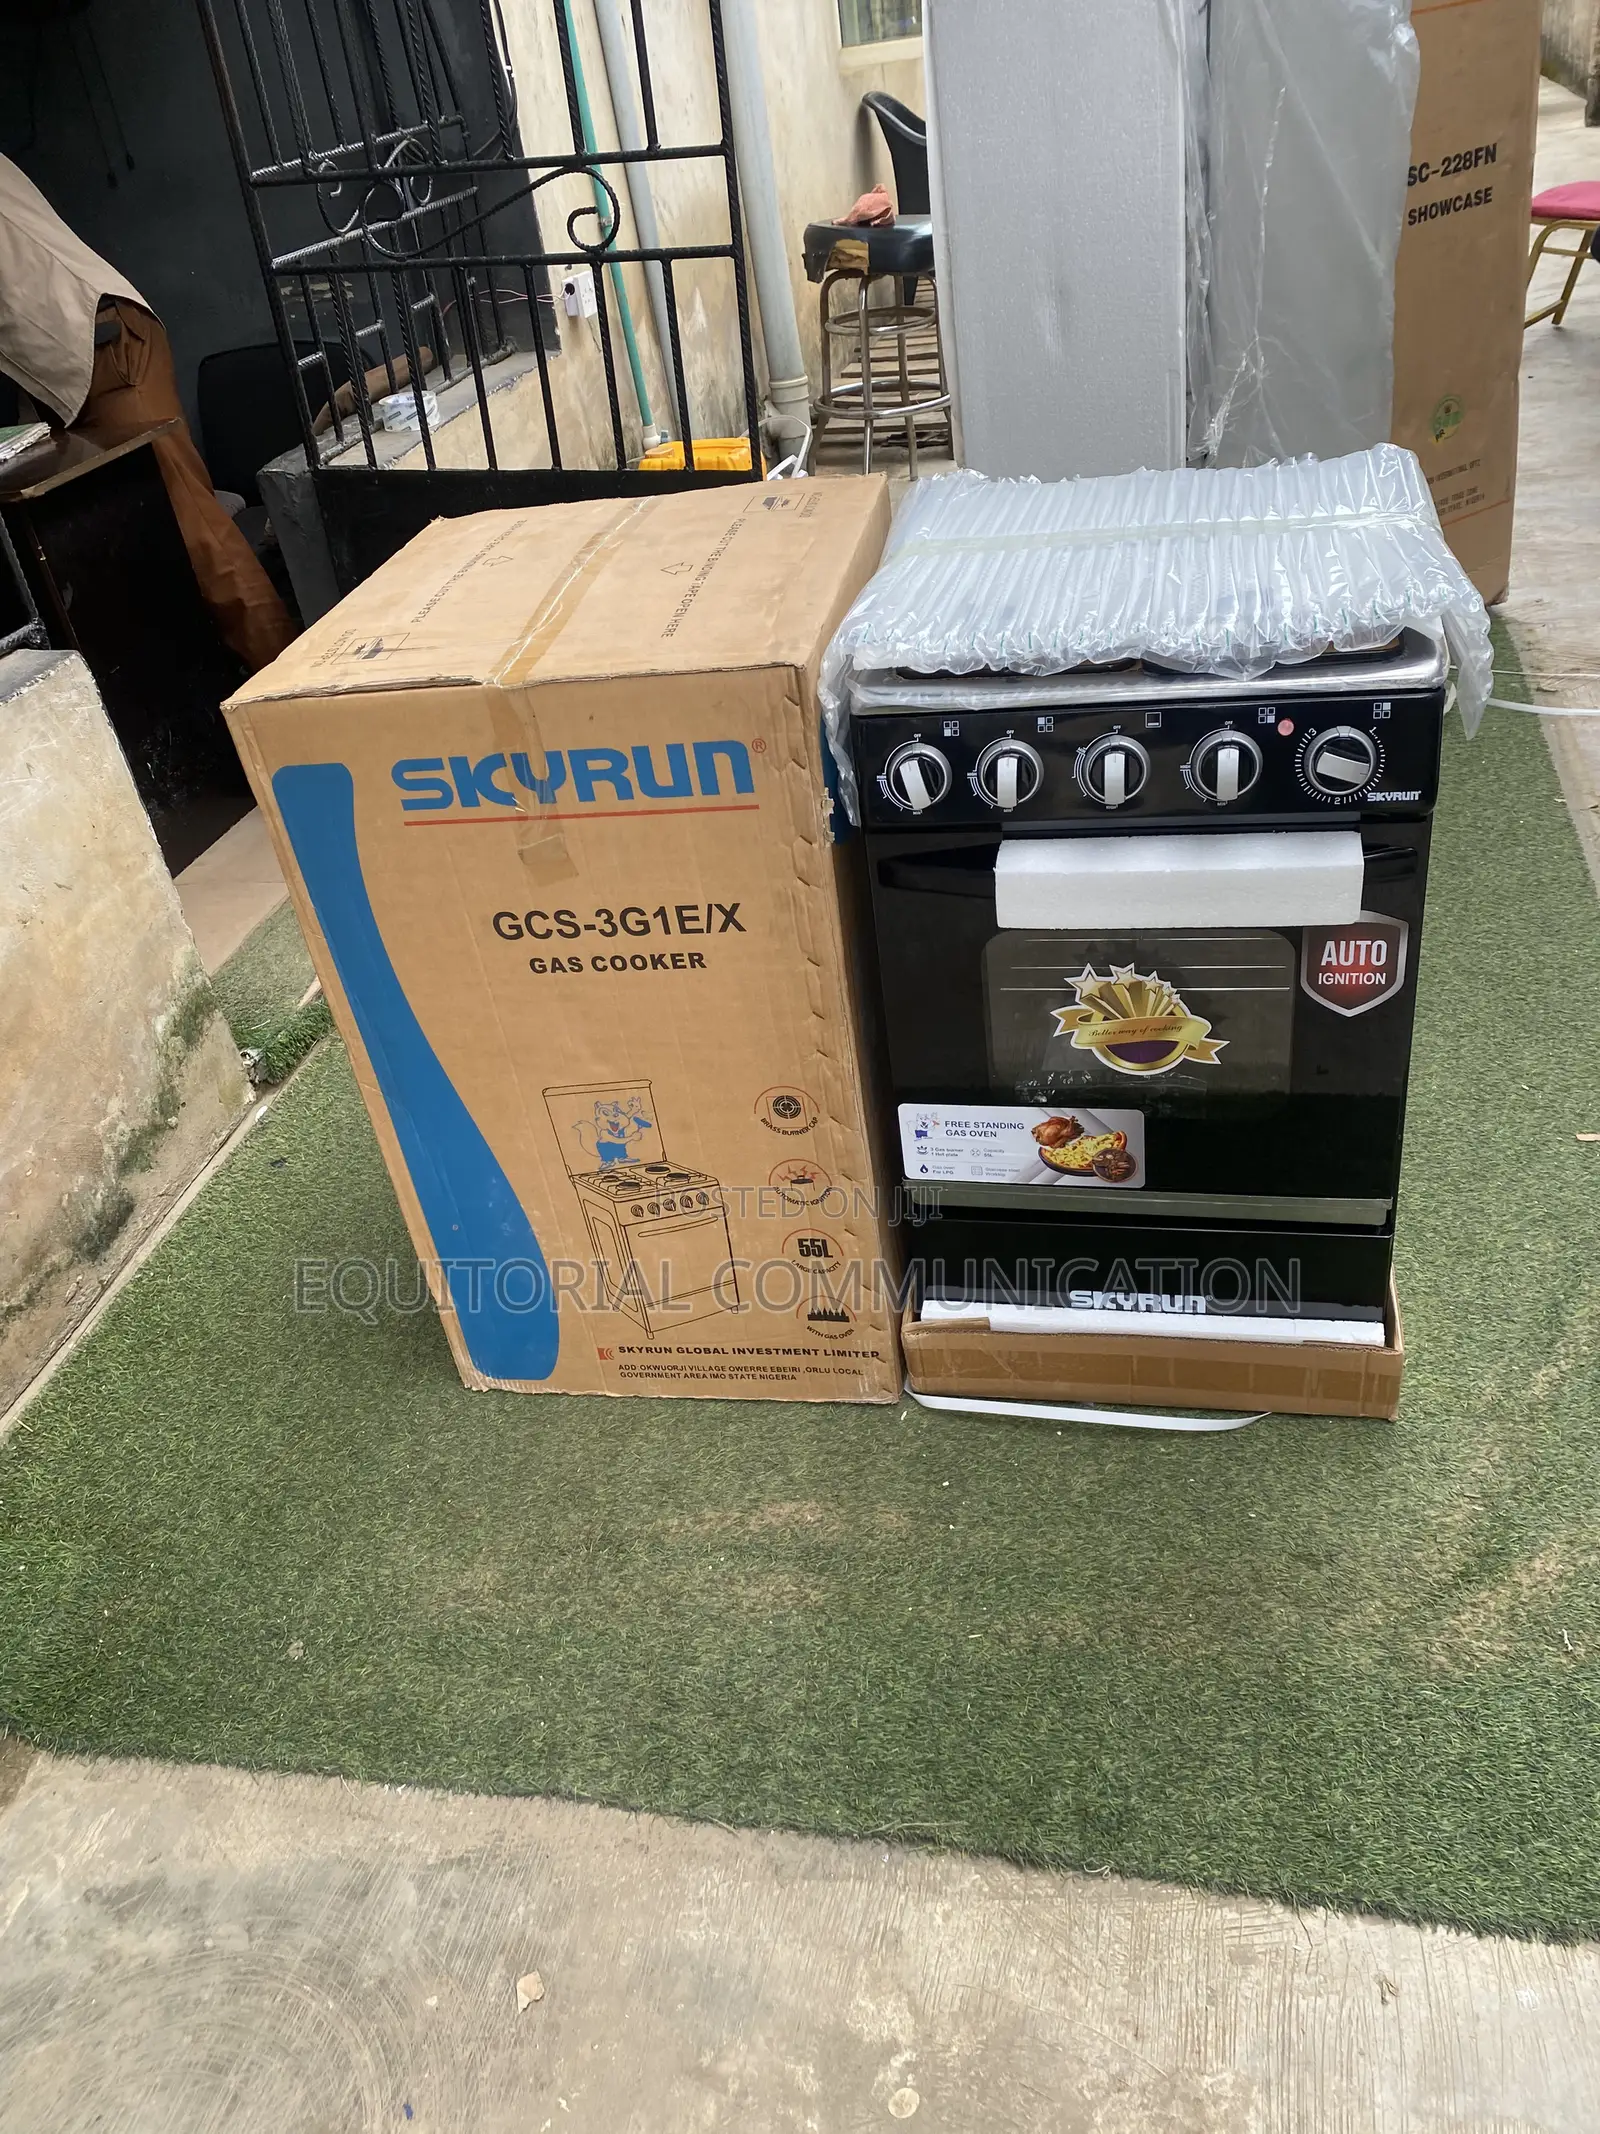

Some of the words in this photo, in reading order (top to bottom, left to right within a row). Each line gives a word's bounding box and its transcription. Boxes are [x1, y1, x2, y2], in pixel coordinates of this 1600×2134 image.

[1408, 143, 1497, 186] SC-228FN
[1408, 186, 1493, 226] SHOWCASE
[725, 518, 746, 536] PLEASE
[716, 537, 733, 547] CUT
[711, 547, 726, 557] THE
[684, 581, 704, 598] TAPE
[410, 597, 441, 623] PLEASE
[672, 598, 693, 618] OPEN
[660, 618, 683, 638] HERE
[1308, 727, 1317, 736] 3
[391, 740, 755, 811] SKYRUN
[1333, 797, 1342, 805] 2
[1367, 791, 1420, 802] SKYRUN
[492, 903, 747, 940] GCS-3G1E/X
[1320, 940, 1388, 967] AUTO
[529, 956, 584, 974] GAS
[591, 952, 708, 973] COOKER
[1318, 972, 1387, 985] IGNITION
[1088, 1028, 1116, 1037] Better
[1118, 1028, 1137, 1037] way
[1139, 1025, 1149, 1035] of
[1149, 1023, 1183, 1033] cooking
[760, 1117, 781, 1134] BRASS
[781, 1126, 811, 1136] BURNER
[808, 1116, 819, 1129] CAP
[944, 1120, 971, 1129] FREE
[973, 1121, 1025, 1130] STANDING
[945, 1129, 967, 1137] GAS
[969, 1130, 998, 1138] OVEN
[773, 1186, 810, 1206] AUTOMATIC
[797, 1238, 834, 1258] 55L
[791, 1260, 811, 1274] LARGE
[812, 1260, 842, 1274] CAPACITY
[1069, 1290, 1206, 1314] SKYRUN
[806, 1325, 824, 1338] WITH
[824, 1332, 839, 1340] GAS
[838, 1328, 855, 1339] OVEN
[618, 1346, 672, 1354] SKYRUN
[676, 1346, 729, 1355] GLOBAL
[731, 1347, 820, 1356] INVESTMENT
[823, 1348, 880, 1359] LIMITED
[620, 1371, 682, 1379] GOVERNMENT
[683, 1372, 709, 1380] AREA
[728, 1372, 757, 1380] STATE
[688, 1364, 727, 1372] VILLAGE
[728, 1365, 768, 1373] OWERRE
[833, 1367, 864, 1376] LOCAL
